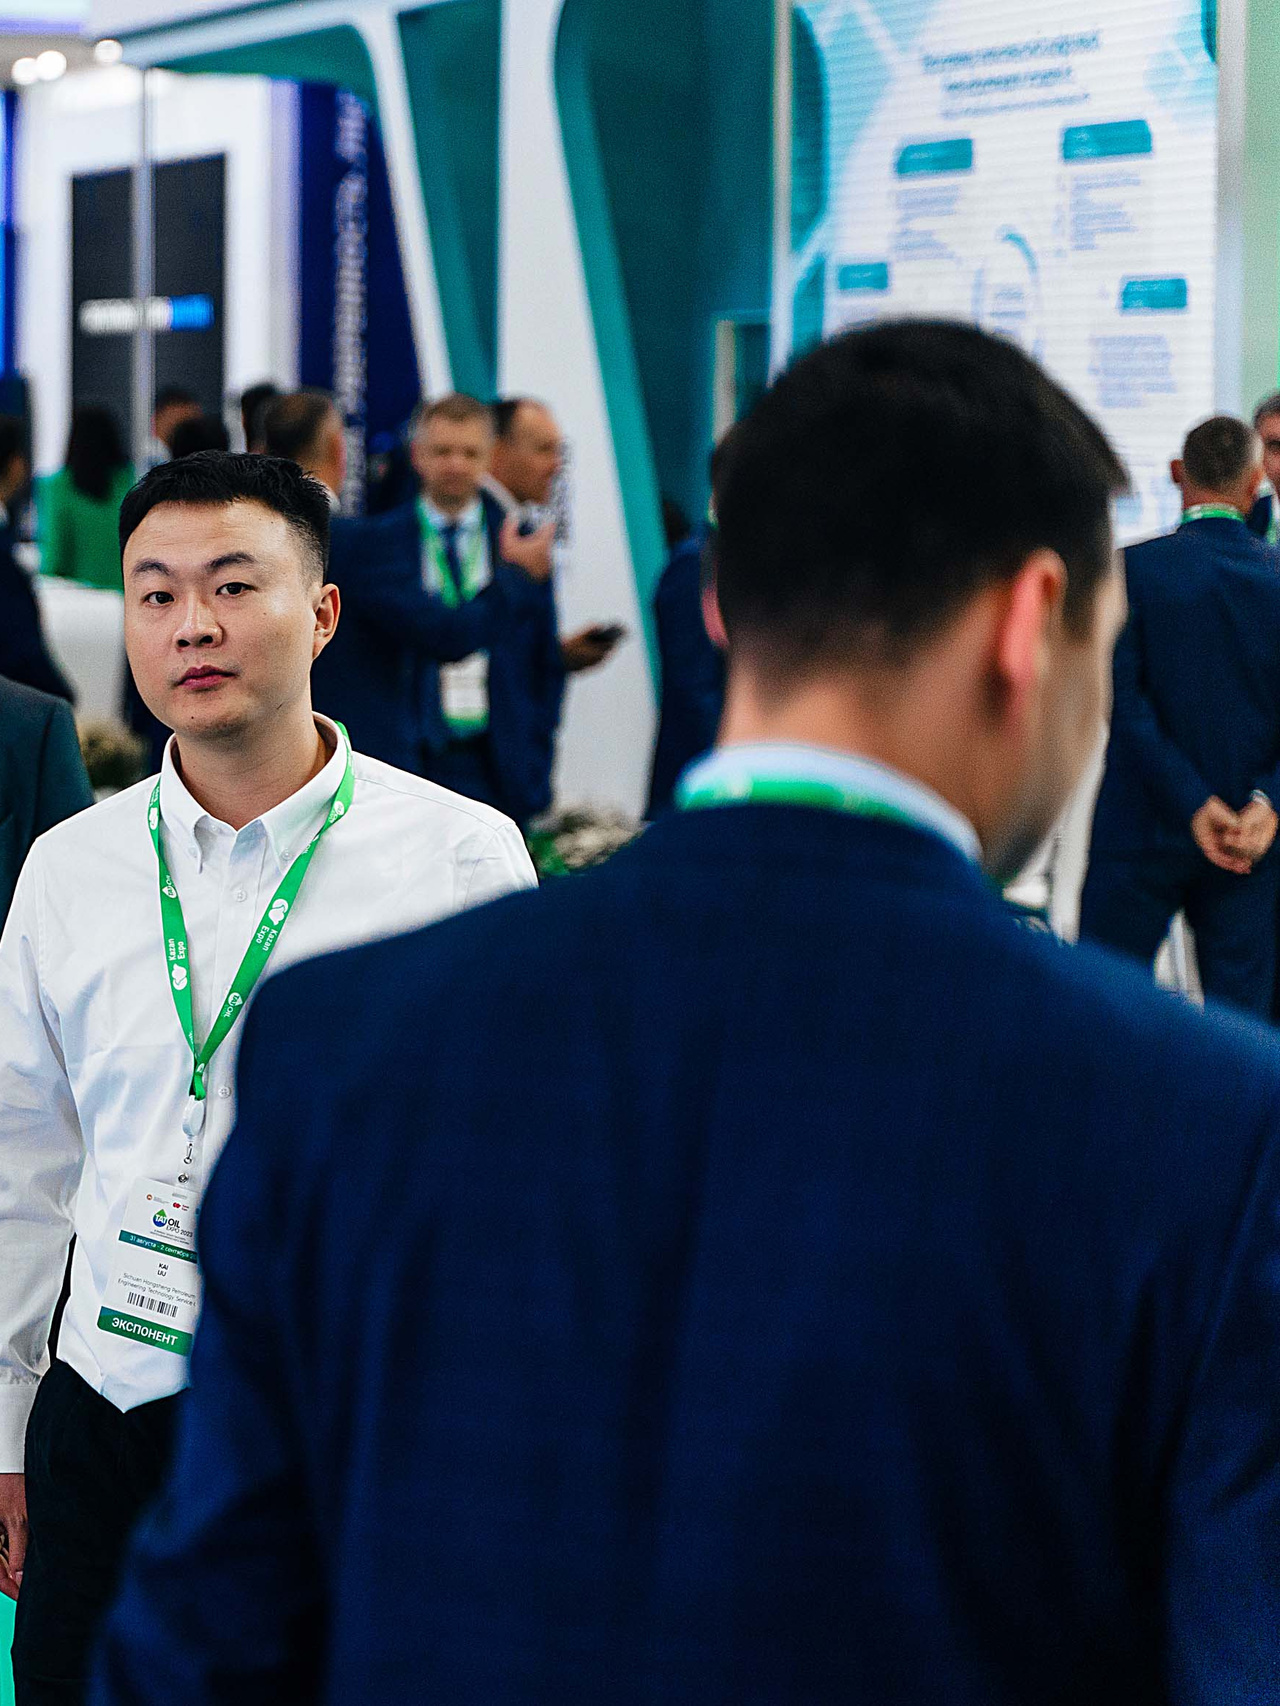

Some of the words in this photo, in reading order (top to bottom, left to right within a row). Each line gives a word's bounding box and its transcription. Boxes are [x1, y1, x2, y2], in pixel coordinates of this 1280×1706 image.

[256, 925, 269, 943] Expo
[262, 929, 278, 951] Kazan
[168, 939, 176, 961] Kazan
[177, 941, 186, 960] Expo
[123, 1272, 142, 1281] Sichuan
[118, 1278, 146, 1292] Engineering
[148, 1287, 174, 1300] Technology
[111, 1317, 179, 1346] ЭКСПОНЕНТ
